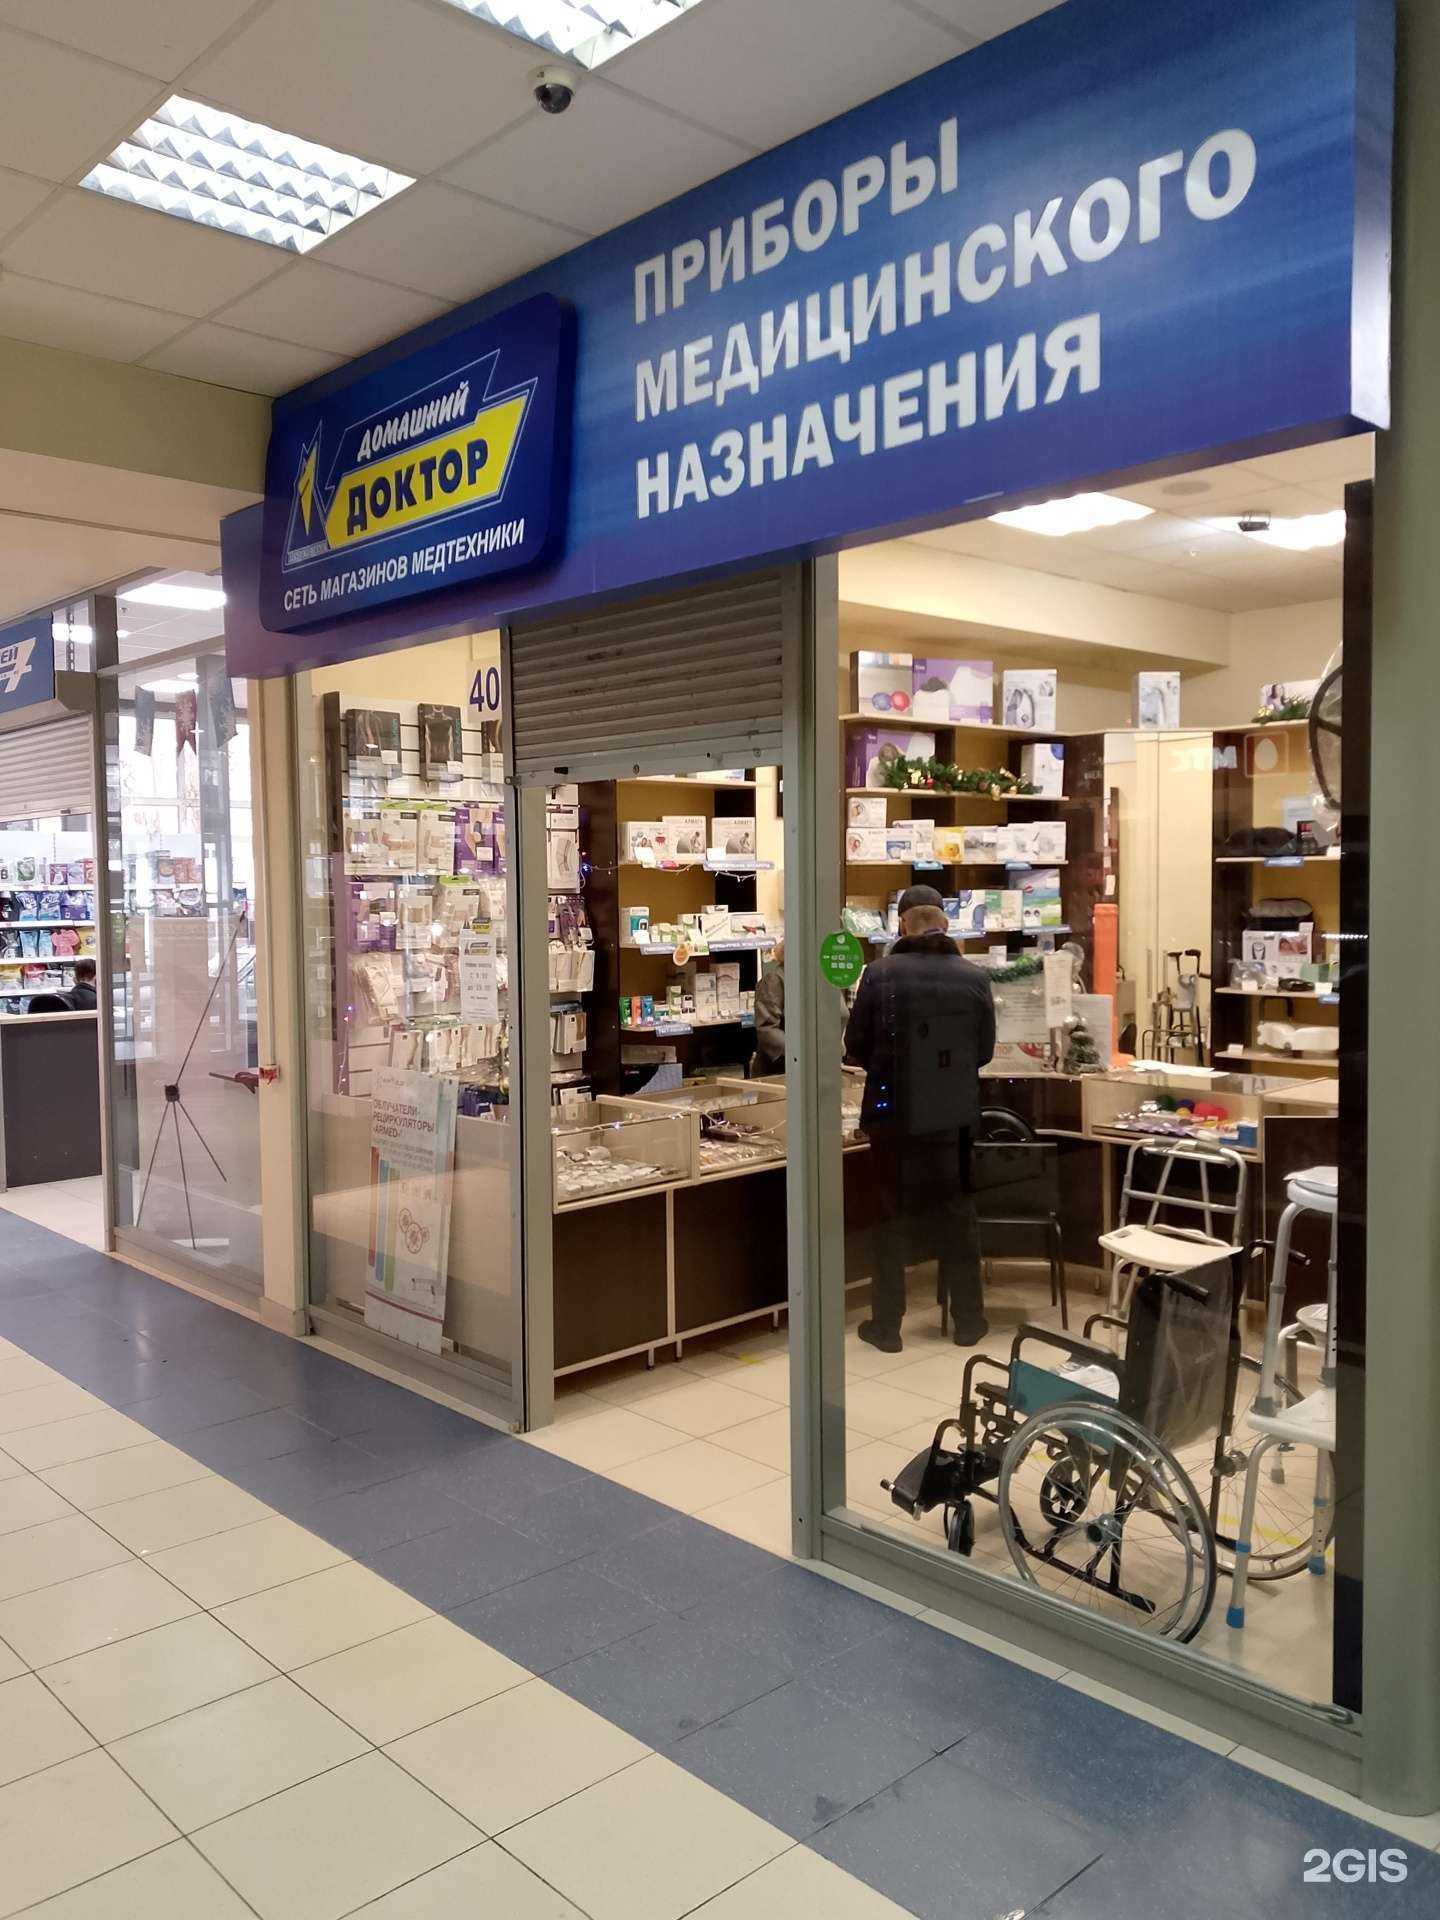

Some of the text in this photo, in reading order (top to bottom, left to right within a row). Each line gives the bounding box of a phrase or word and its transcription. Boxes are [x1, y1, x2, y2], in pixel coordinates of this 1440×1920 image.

[634, 117, 958, 325] ПРИБОРЫ
[635, 128, 1257, 422] МЕДИЦИНСКОГО
[357, 380, 471, 462] ДОМАШНИЙ
[636, 313, 1101, 520] НАЗНАЧЕНИЯ
[347, 438, 489, 537] ДОКТОР
[284, 518, 525, 611] СЕТЬ МАГАЗИНОВ МЕДТЕХНИКИ
[469, 666, 500, 712] 40
